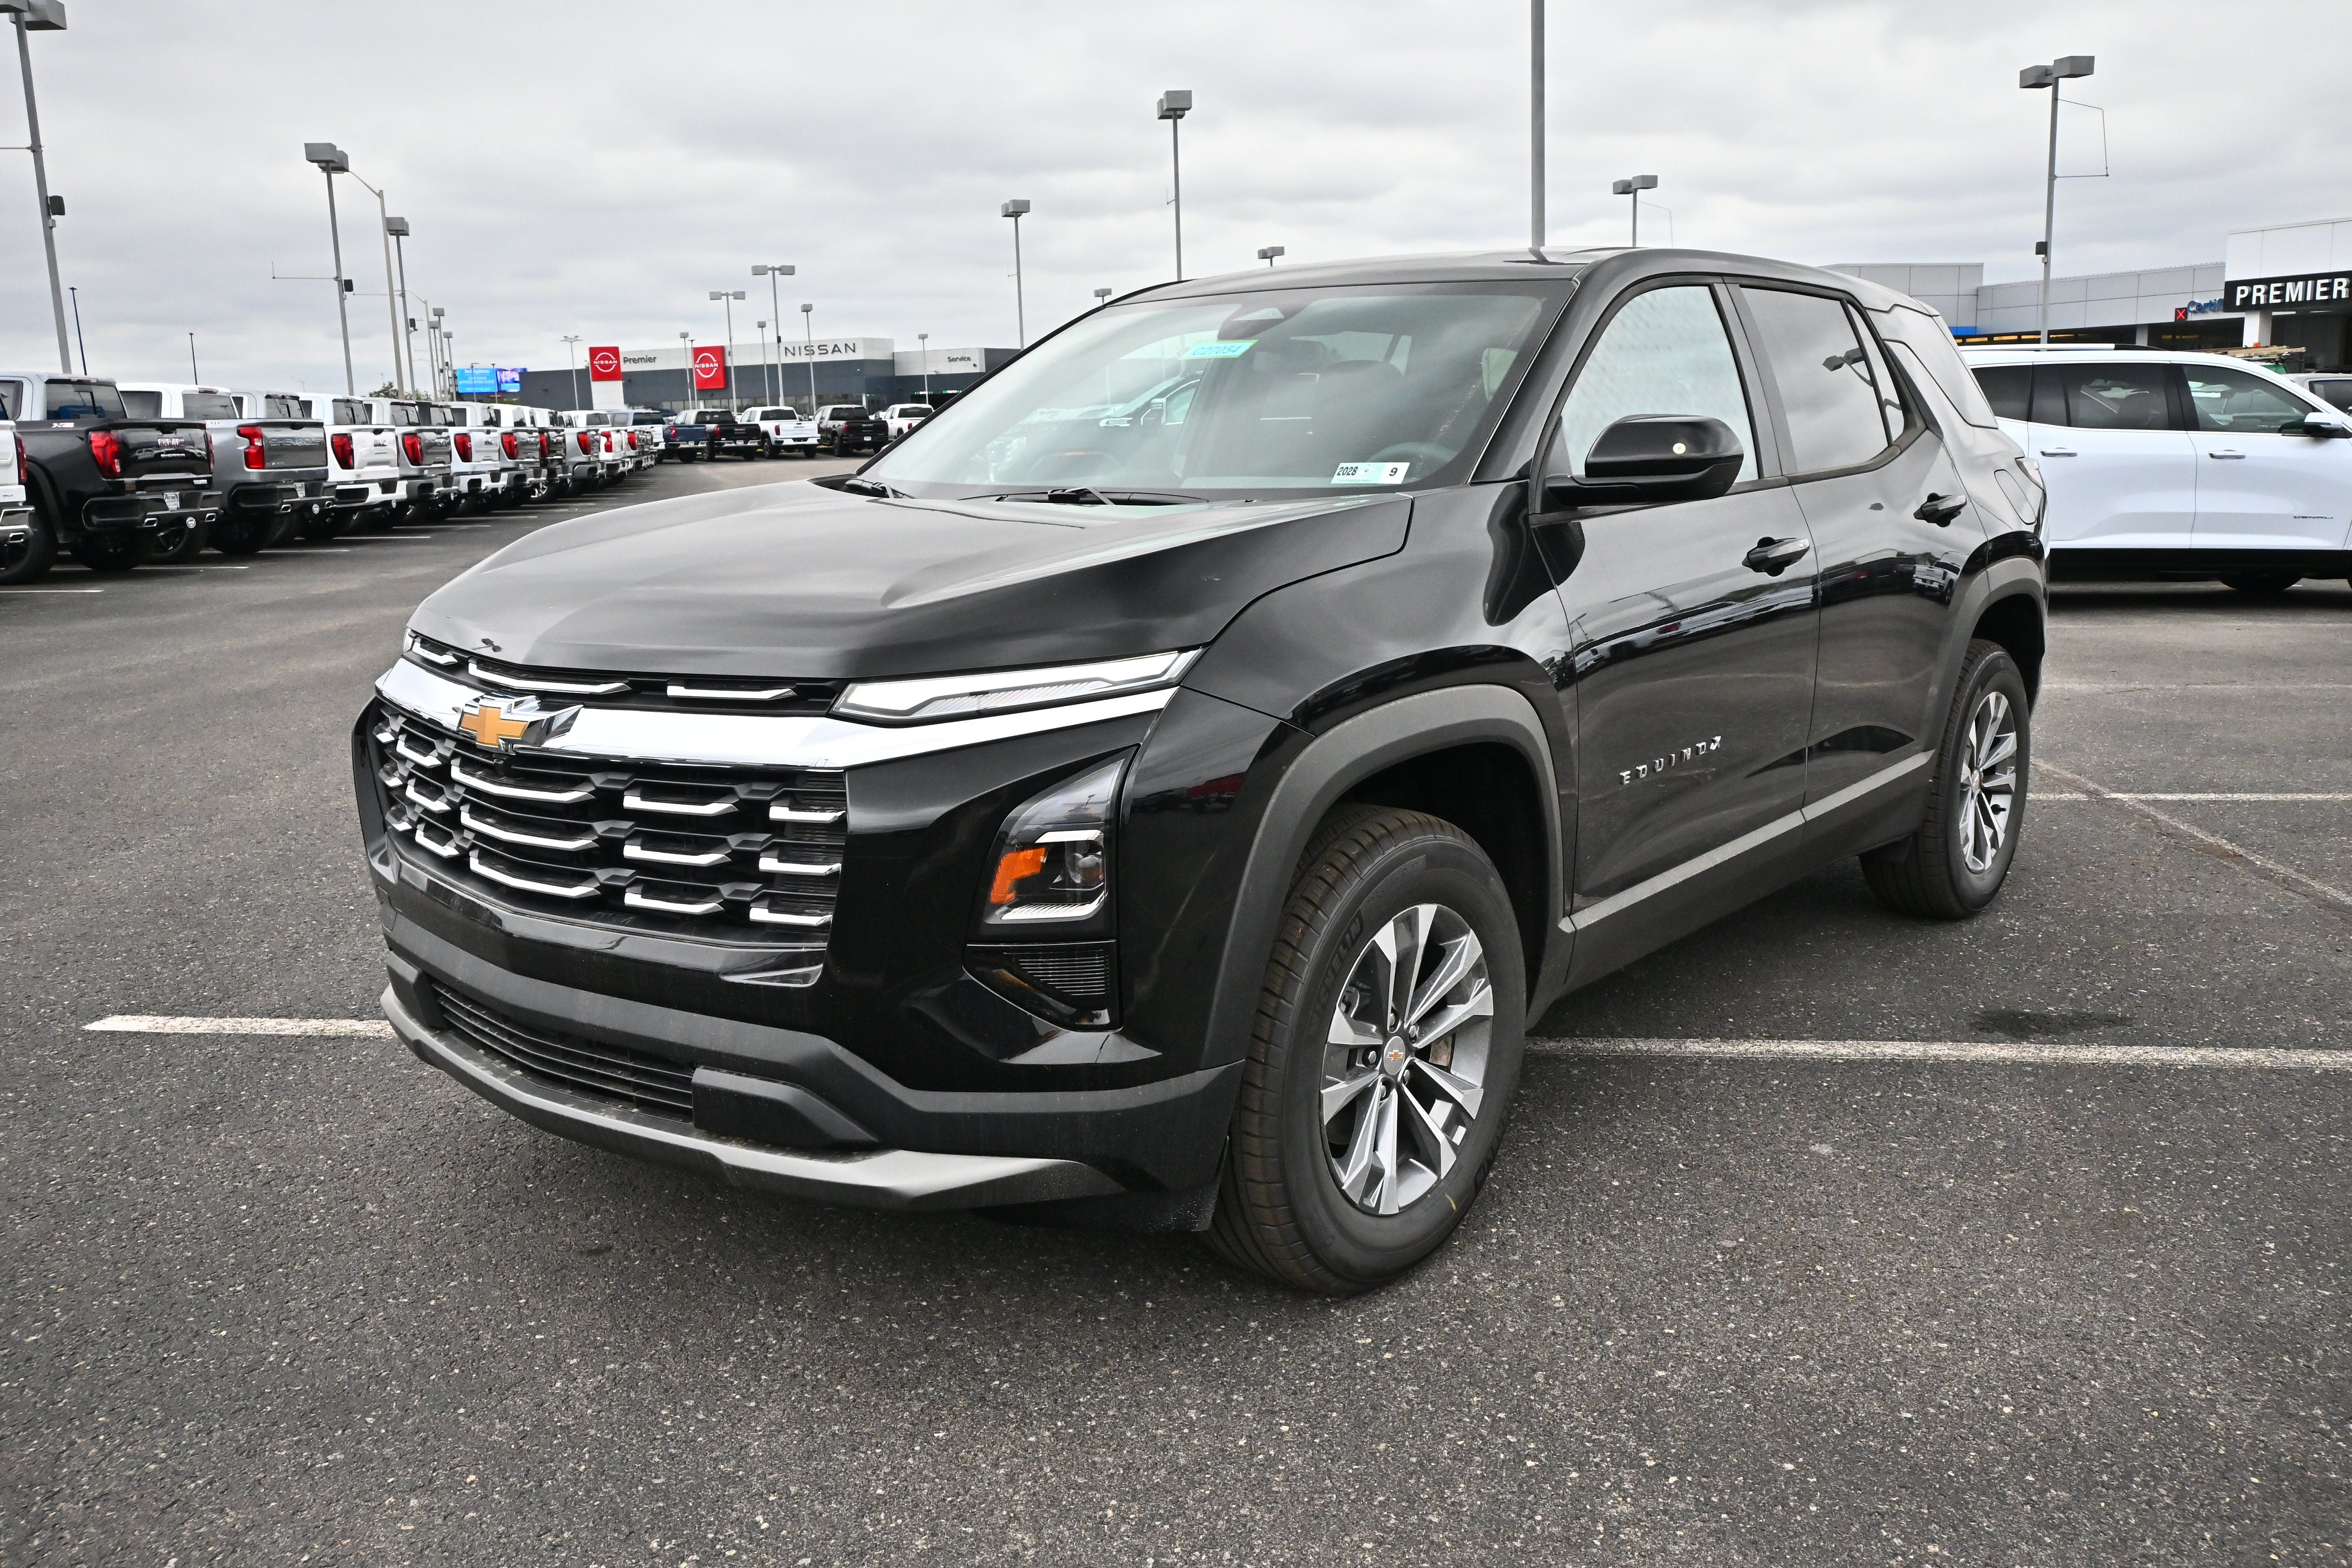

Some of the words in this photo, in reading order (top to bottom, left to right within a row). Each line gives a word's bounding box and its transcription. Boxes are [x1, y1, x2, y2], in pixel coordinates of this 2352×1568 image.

[2235, 277, 2350, 306] PREMIER
[784, 343, 856, 357] NISSAN
[1192, 345, 1242, 355] C27054
[623, 355, 657, 364] Premier
[1337, 466, 1358, 476] 2028
[1389, 467, 1398, 476] 9
[1619, 736, 1722, 785] EQUINOX
